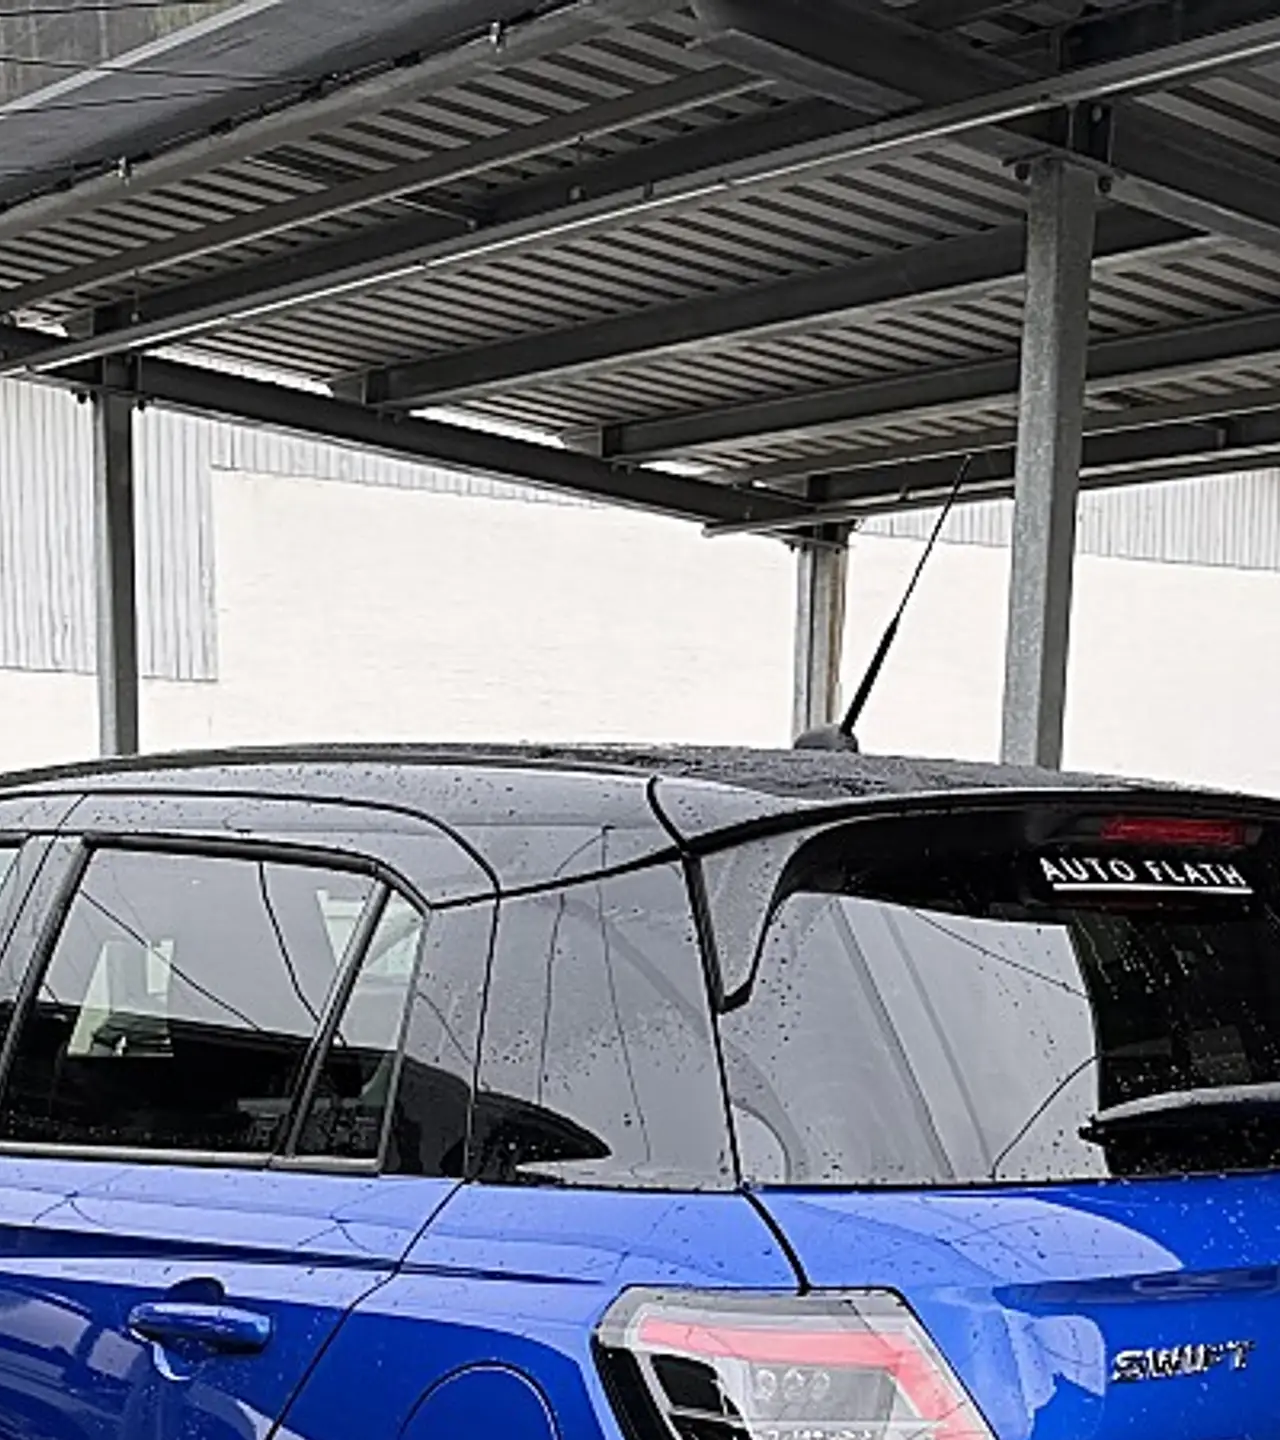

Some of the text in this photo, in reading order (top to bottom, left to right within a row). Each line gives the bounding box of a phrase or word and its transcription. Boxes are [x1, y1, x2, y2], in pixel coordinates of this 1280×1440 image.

[1039, 857, 1247, 886] AUTO FLATH
[1110, 1339, 1256, 1382] SWIFT
